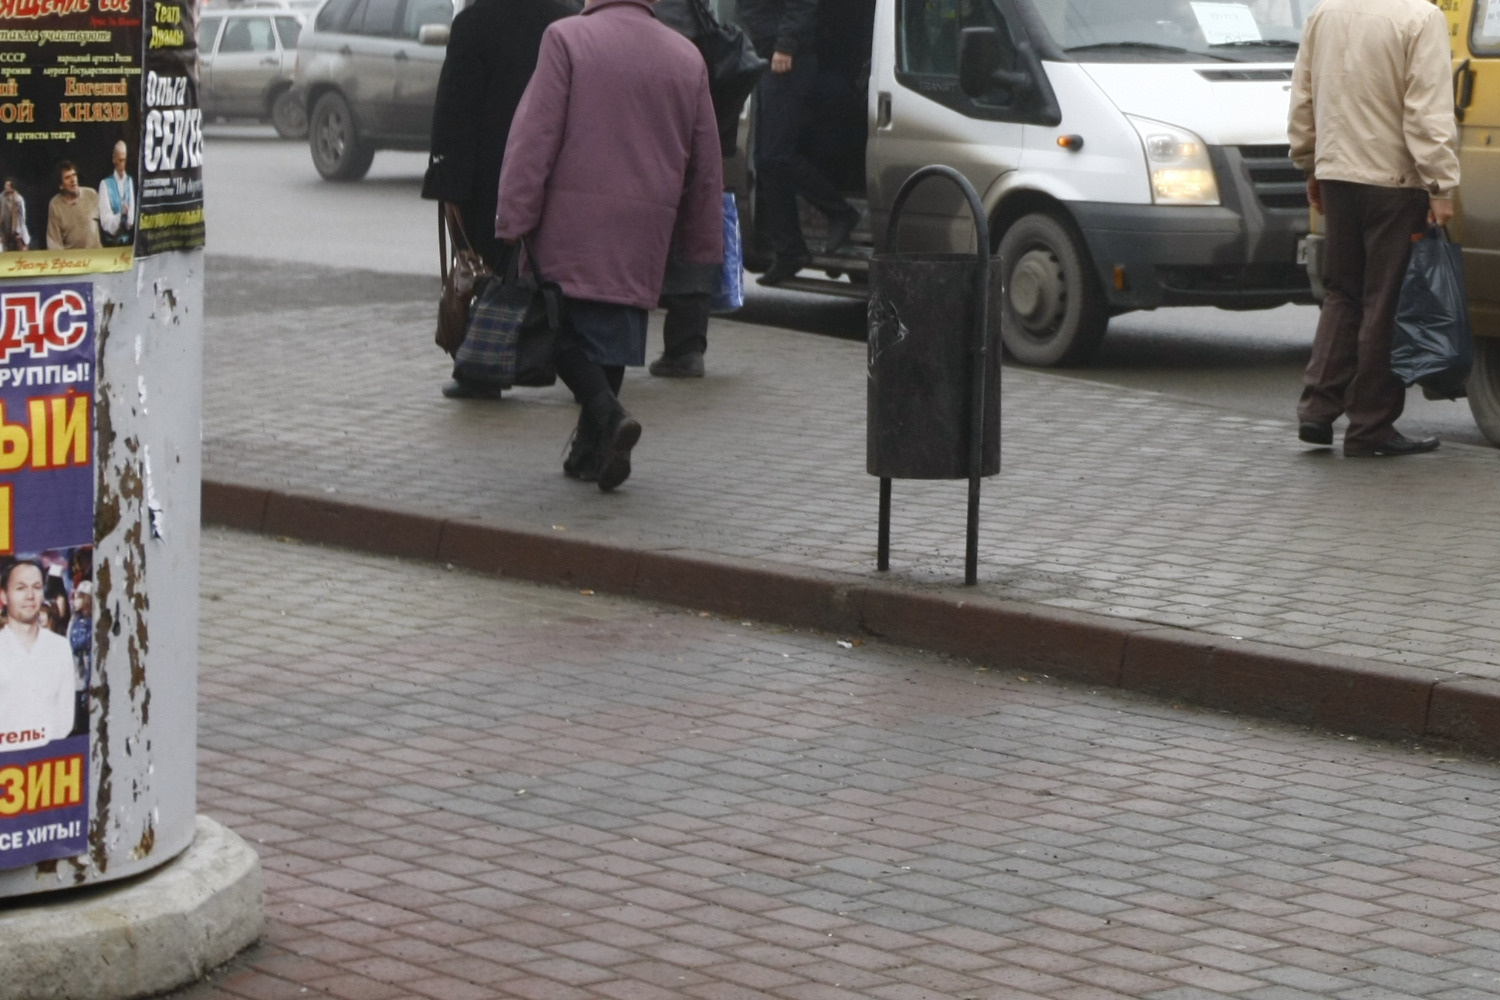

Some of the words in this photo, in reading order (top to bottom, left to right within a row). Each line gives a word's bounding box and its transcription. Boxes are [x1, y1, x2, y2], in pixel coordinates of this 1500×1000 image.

[146, 70, 188, 107] Ольга
[15, 132, 49, 143] артисты
[26, 820, 81, 846] ХИТЫ!
